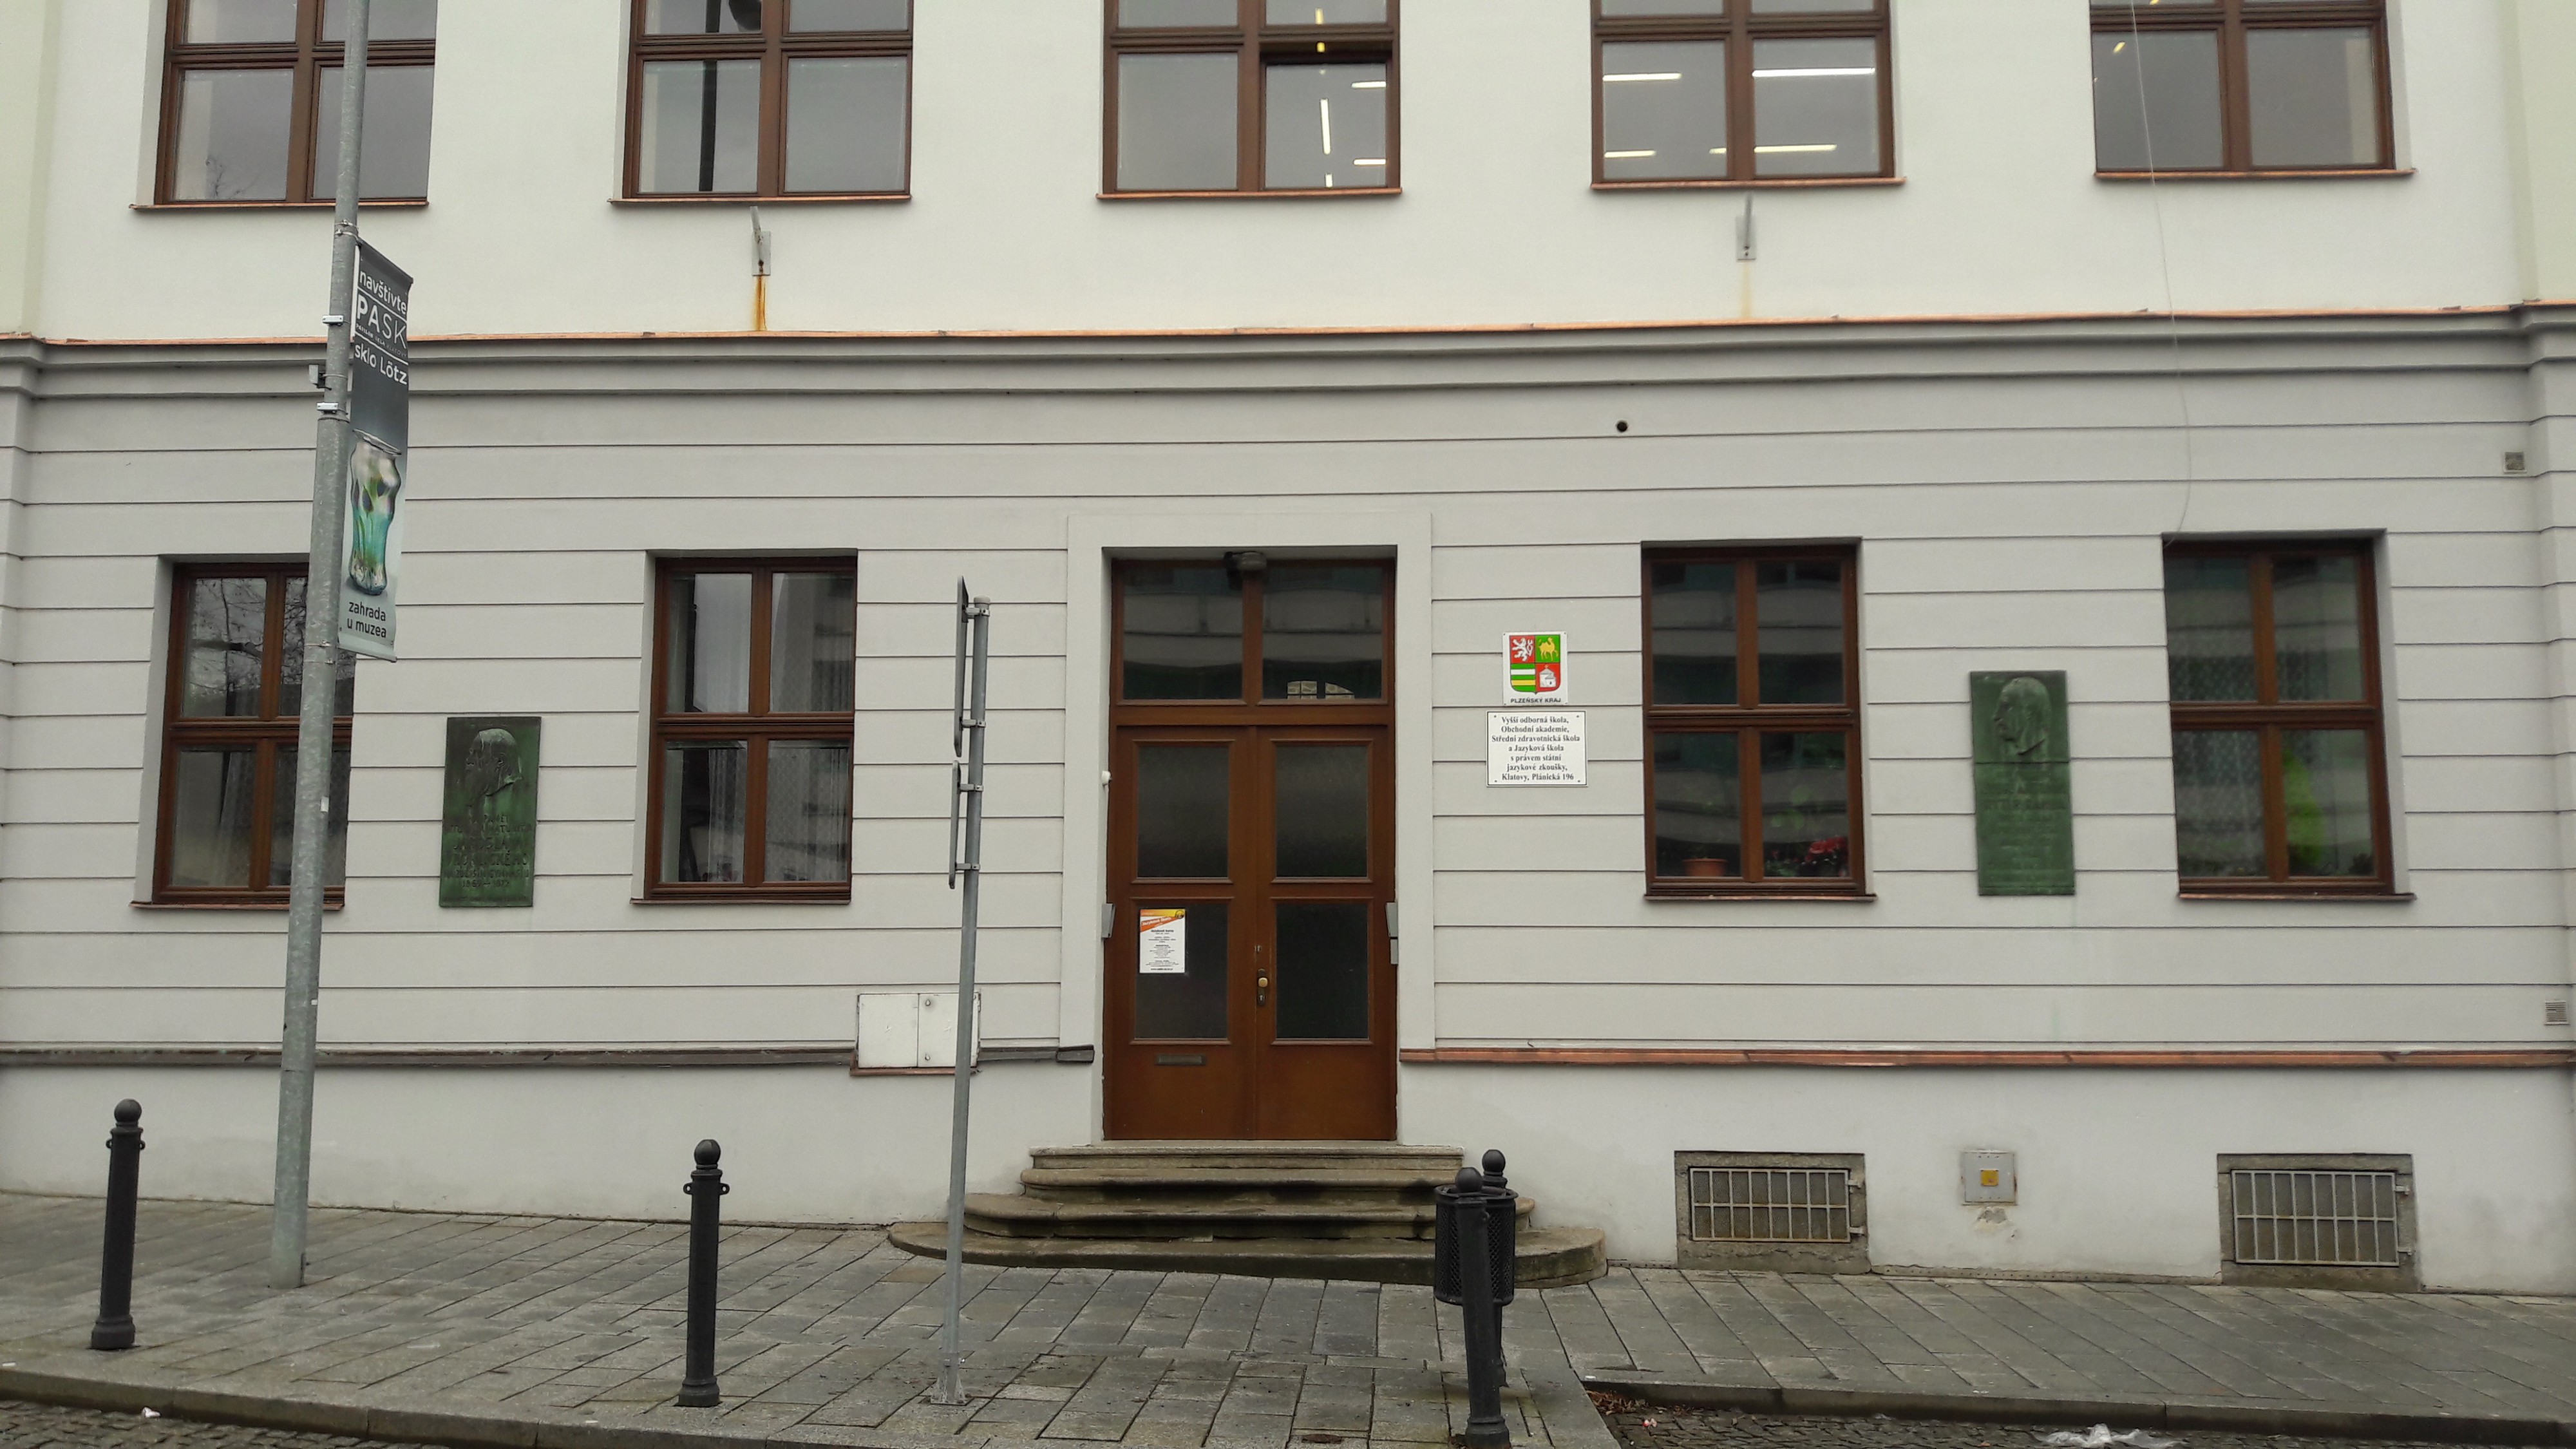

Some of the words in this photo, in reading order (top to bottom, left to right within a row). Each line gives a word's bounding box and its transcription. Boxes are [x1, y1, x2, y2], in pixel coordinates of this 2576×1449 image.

[360, 270, 406, 314] navštivte
[357, 294, 406, 349] PASK
[355, 343, 377, 368] sklo
[380, 356, 407, 385] Lötz
[348, 601, 386, 621] zahrada
[347, 618, 353, 629] u
[355, 620, 386, 638] muzea
[1502, 716, 1519, 724] Vyšší
[1549, 715, 1569, 724] škola,
[1514, 744, 1545, 753] Jazyková
[1515, 754, 1540, 762] právem
[1506, 763, 1536, 772] jazykové
[1539, 763, 1567, 772] zkoušky,
[1502, 773, 1530, 782] Klatovy,
